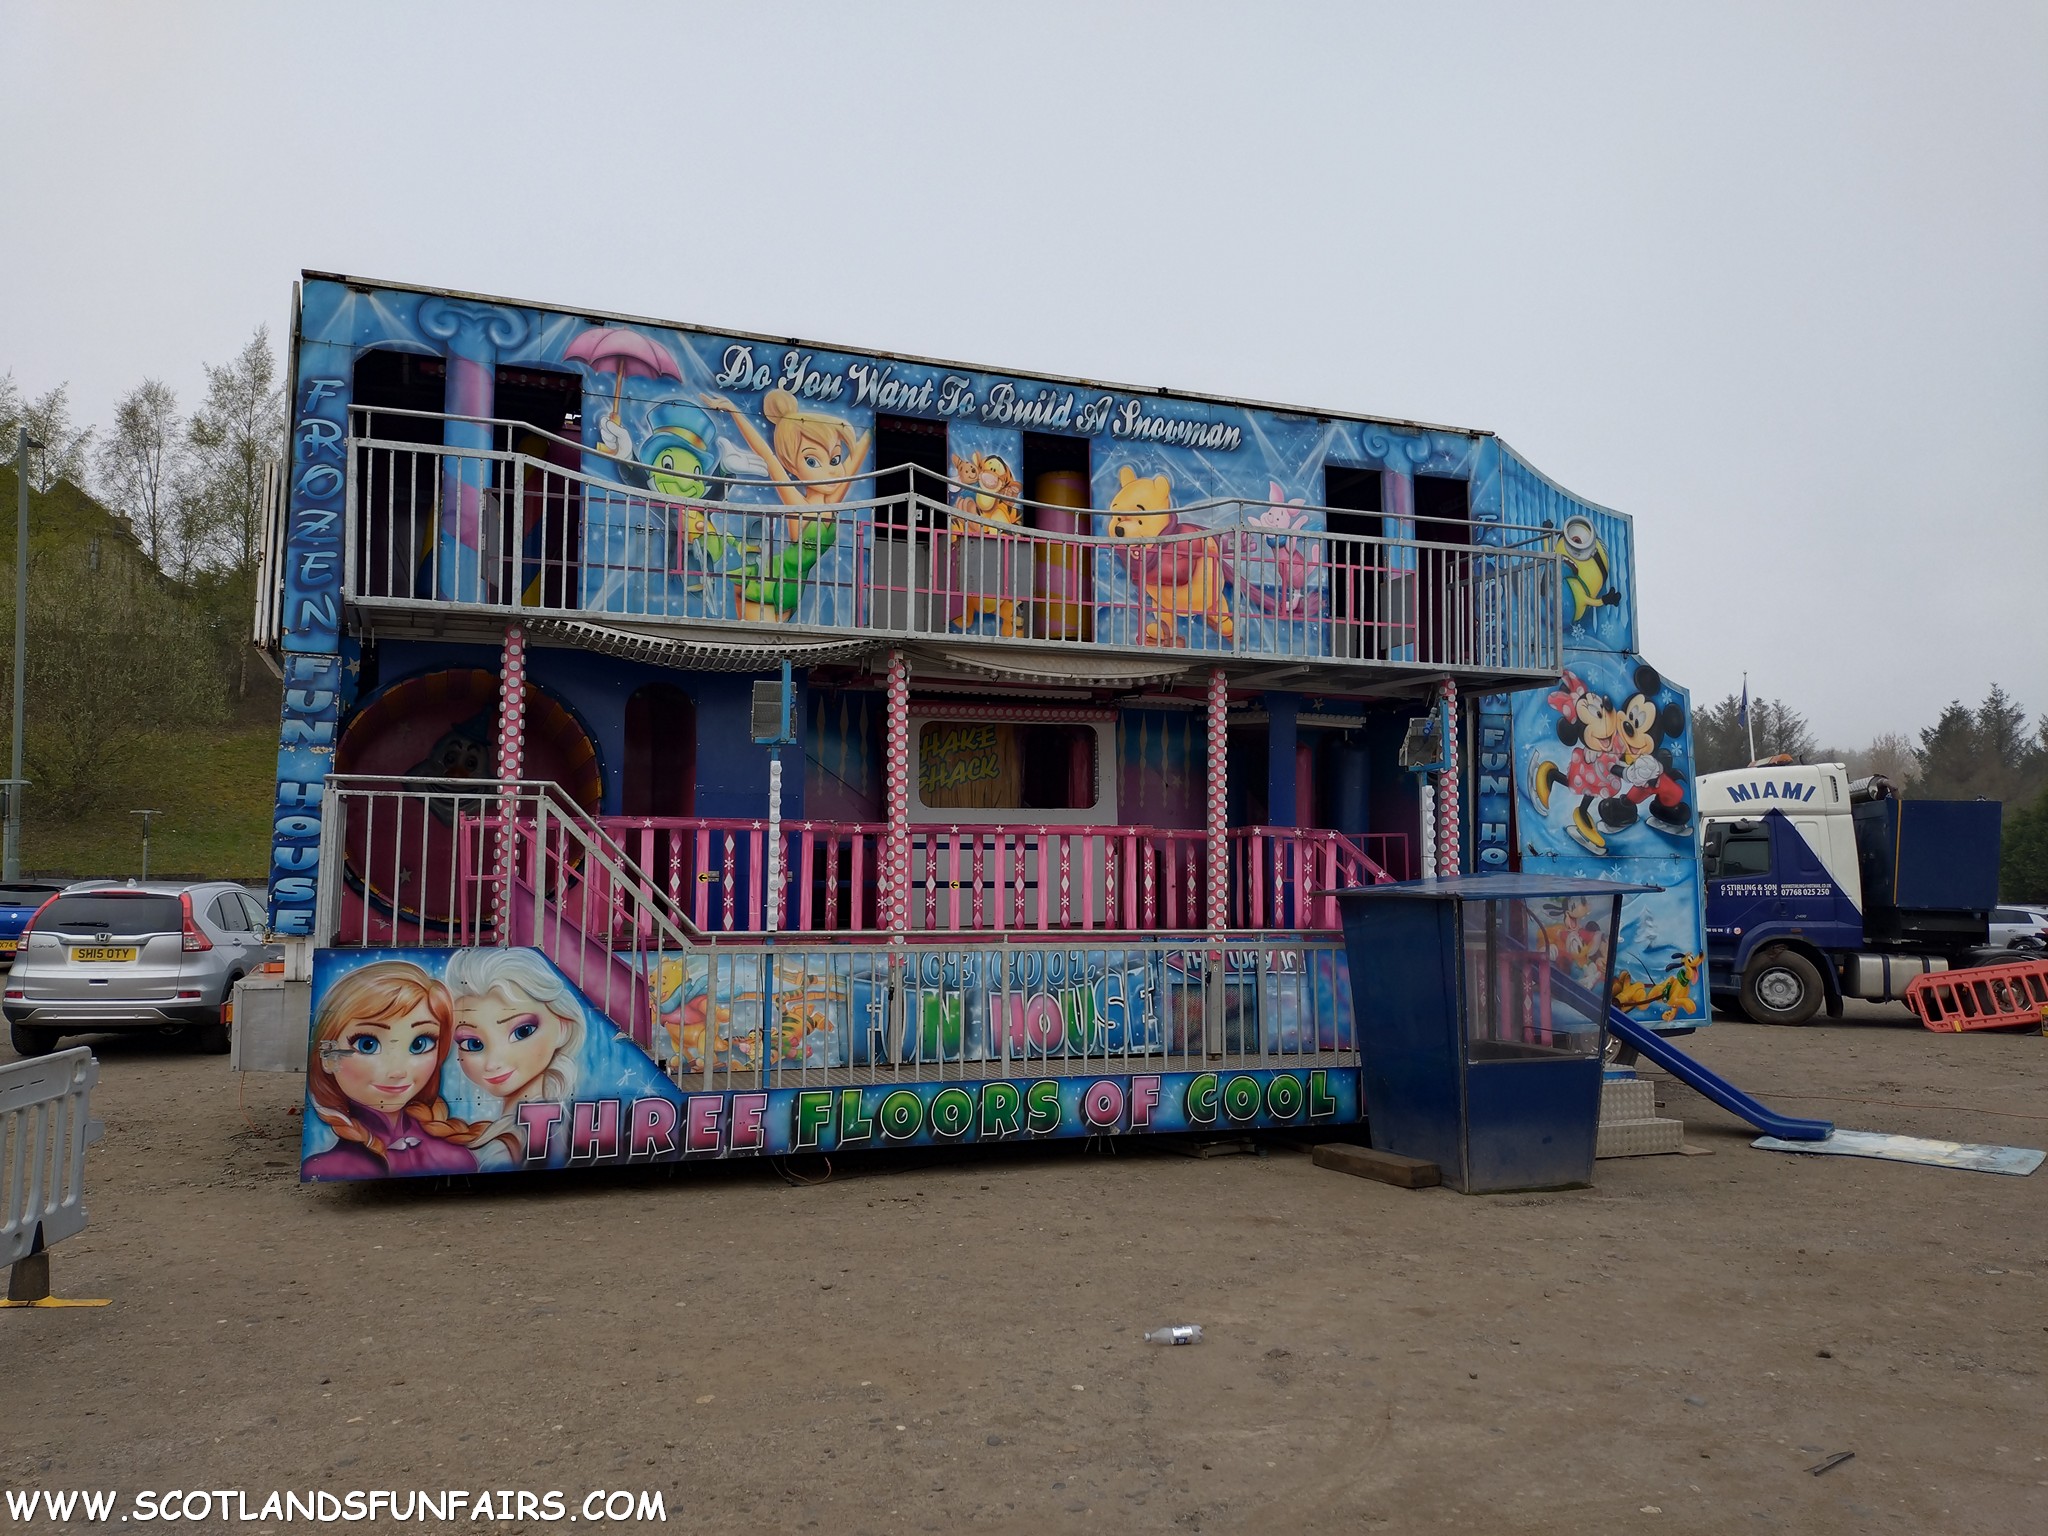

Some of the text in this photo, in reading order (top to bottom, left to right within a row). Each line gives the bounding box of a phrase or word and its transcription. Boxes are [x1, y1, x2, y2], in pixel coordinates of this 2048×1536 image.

[715, 344, 1241, 452] Do You Want To Build A Snowman
[273, 379, 346, 934] FROZEN FUN HOUSE
[1480, 728, 1509, 796] FUN
[1726, 781, 1817, 803] MIAMI
[78, 948, 130, 958] SH15 OTY
[989, 963, 1160, 1060] HOUSE
[517, 1092, 769, 1162] THREE
[795, 1079, 1062, 1149] FLOORS
[1084, 1074, 1162, 1128] OF
[1186, 1069, 1336, 1124] COOL
